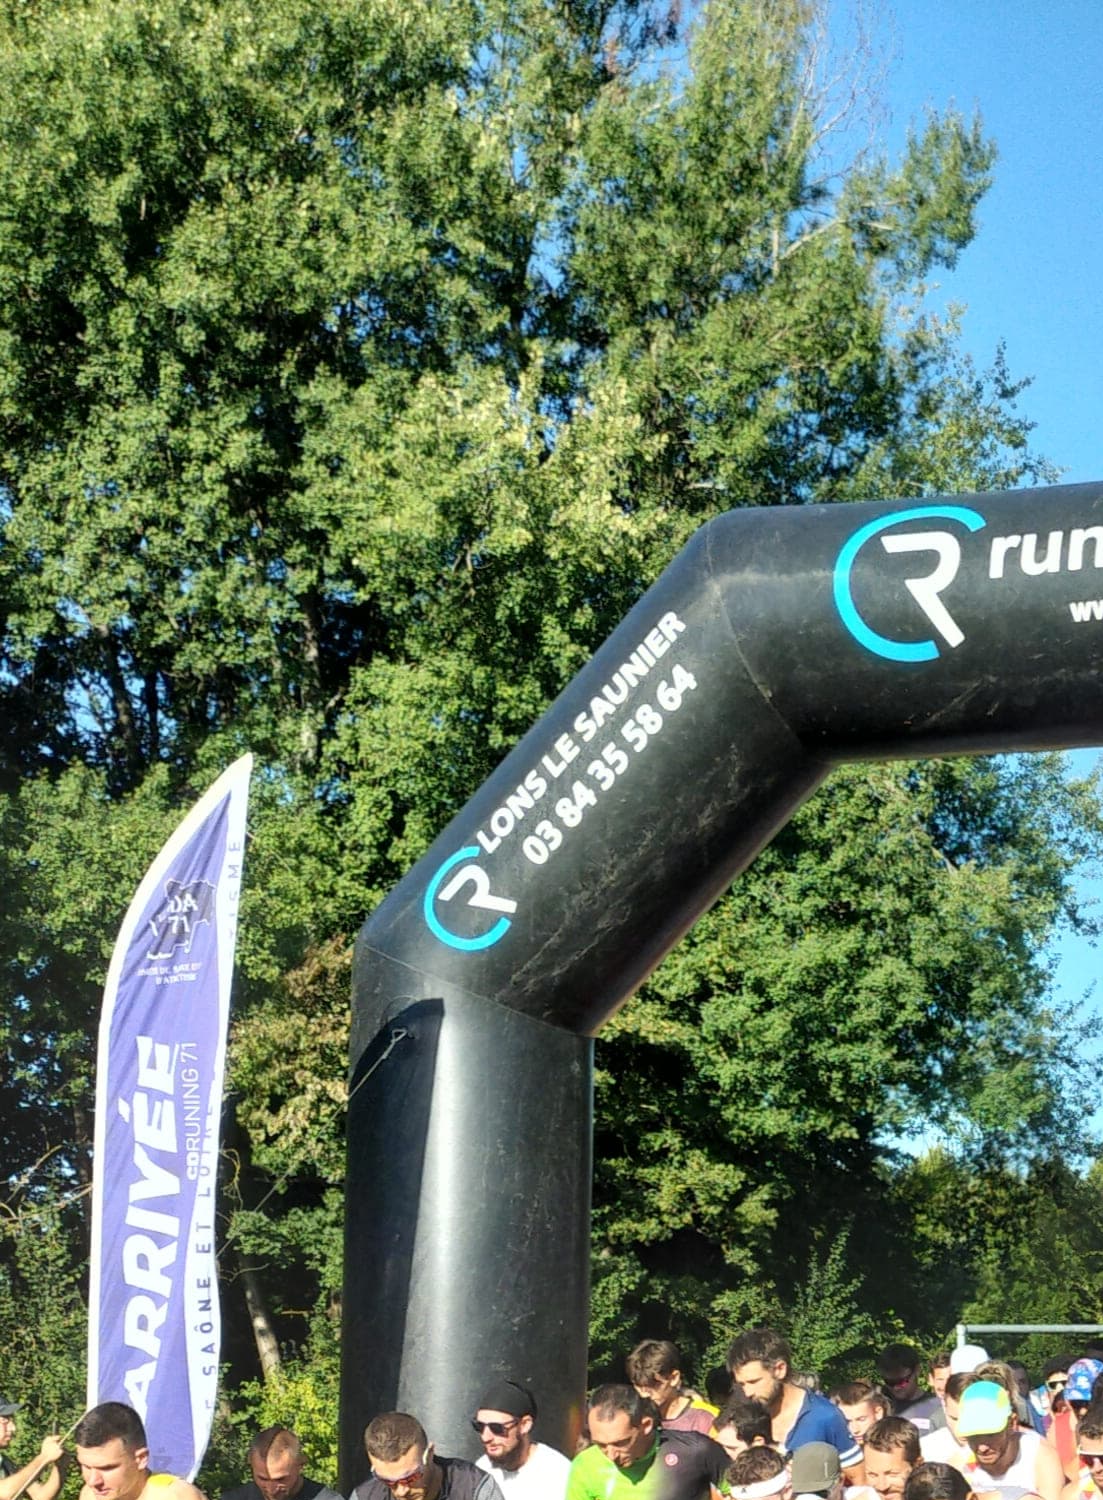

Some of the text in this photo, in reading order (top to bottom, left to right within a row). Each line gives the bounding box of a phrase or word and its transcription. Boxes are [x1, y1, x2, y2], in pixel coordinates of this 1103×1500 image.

[476, 611, 687, 854] LONS LE SAUNIER
[522, 664, 697, 865] 03 84 35 58 64
[117, 1035, 180, 1426] ARRIVÉE
[194, 1276, 217, 1377] SAÔNE
[196, 1222, 212, 1254] ET
